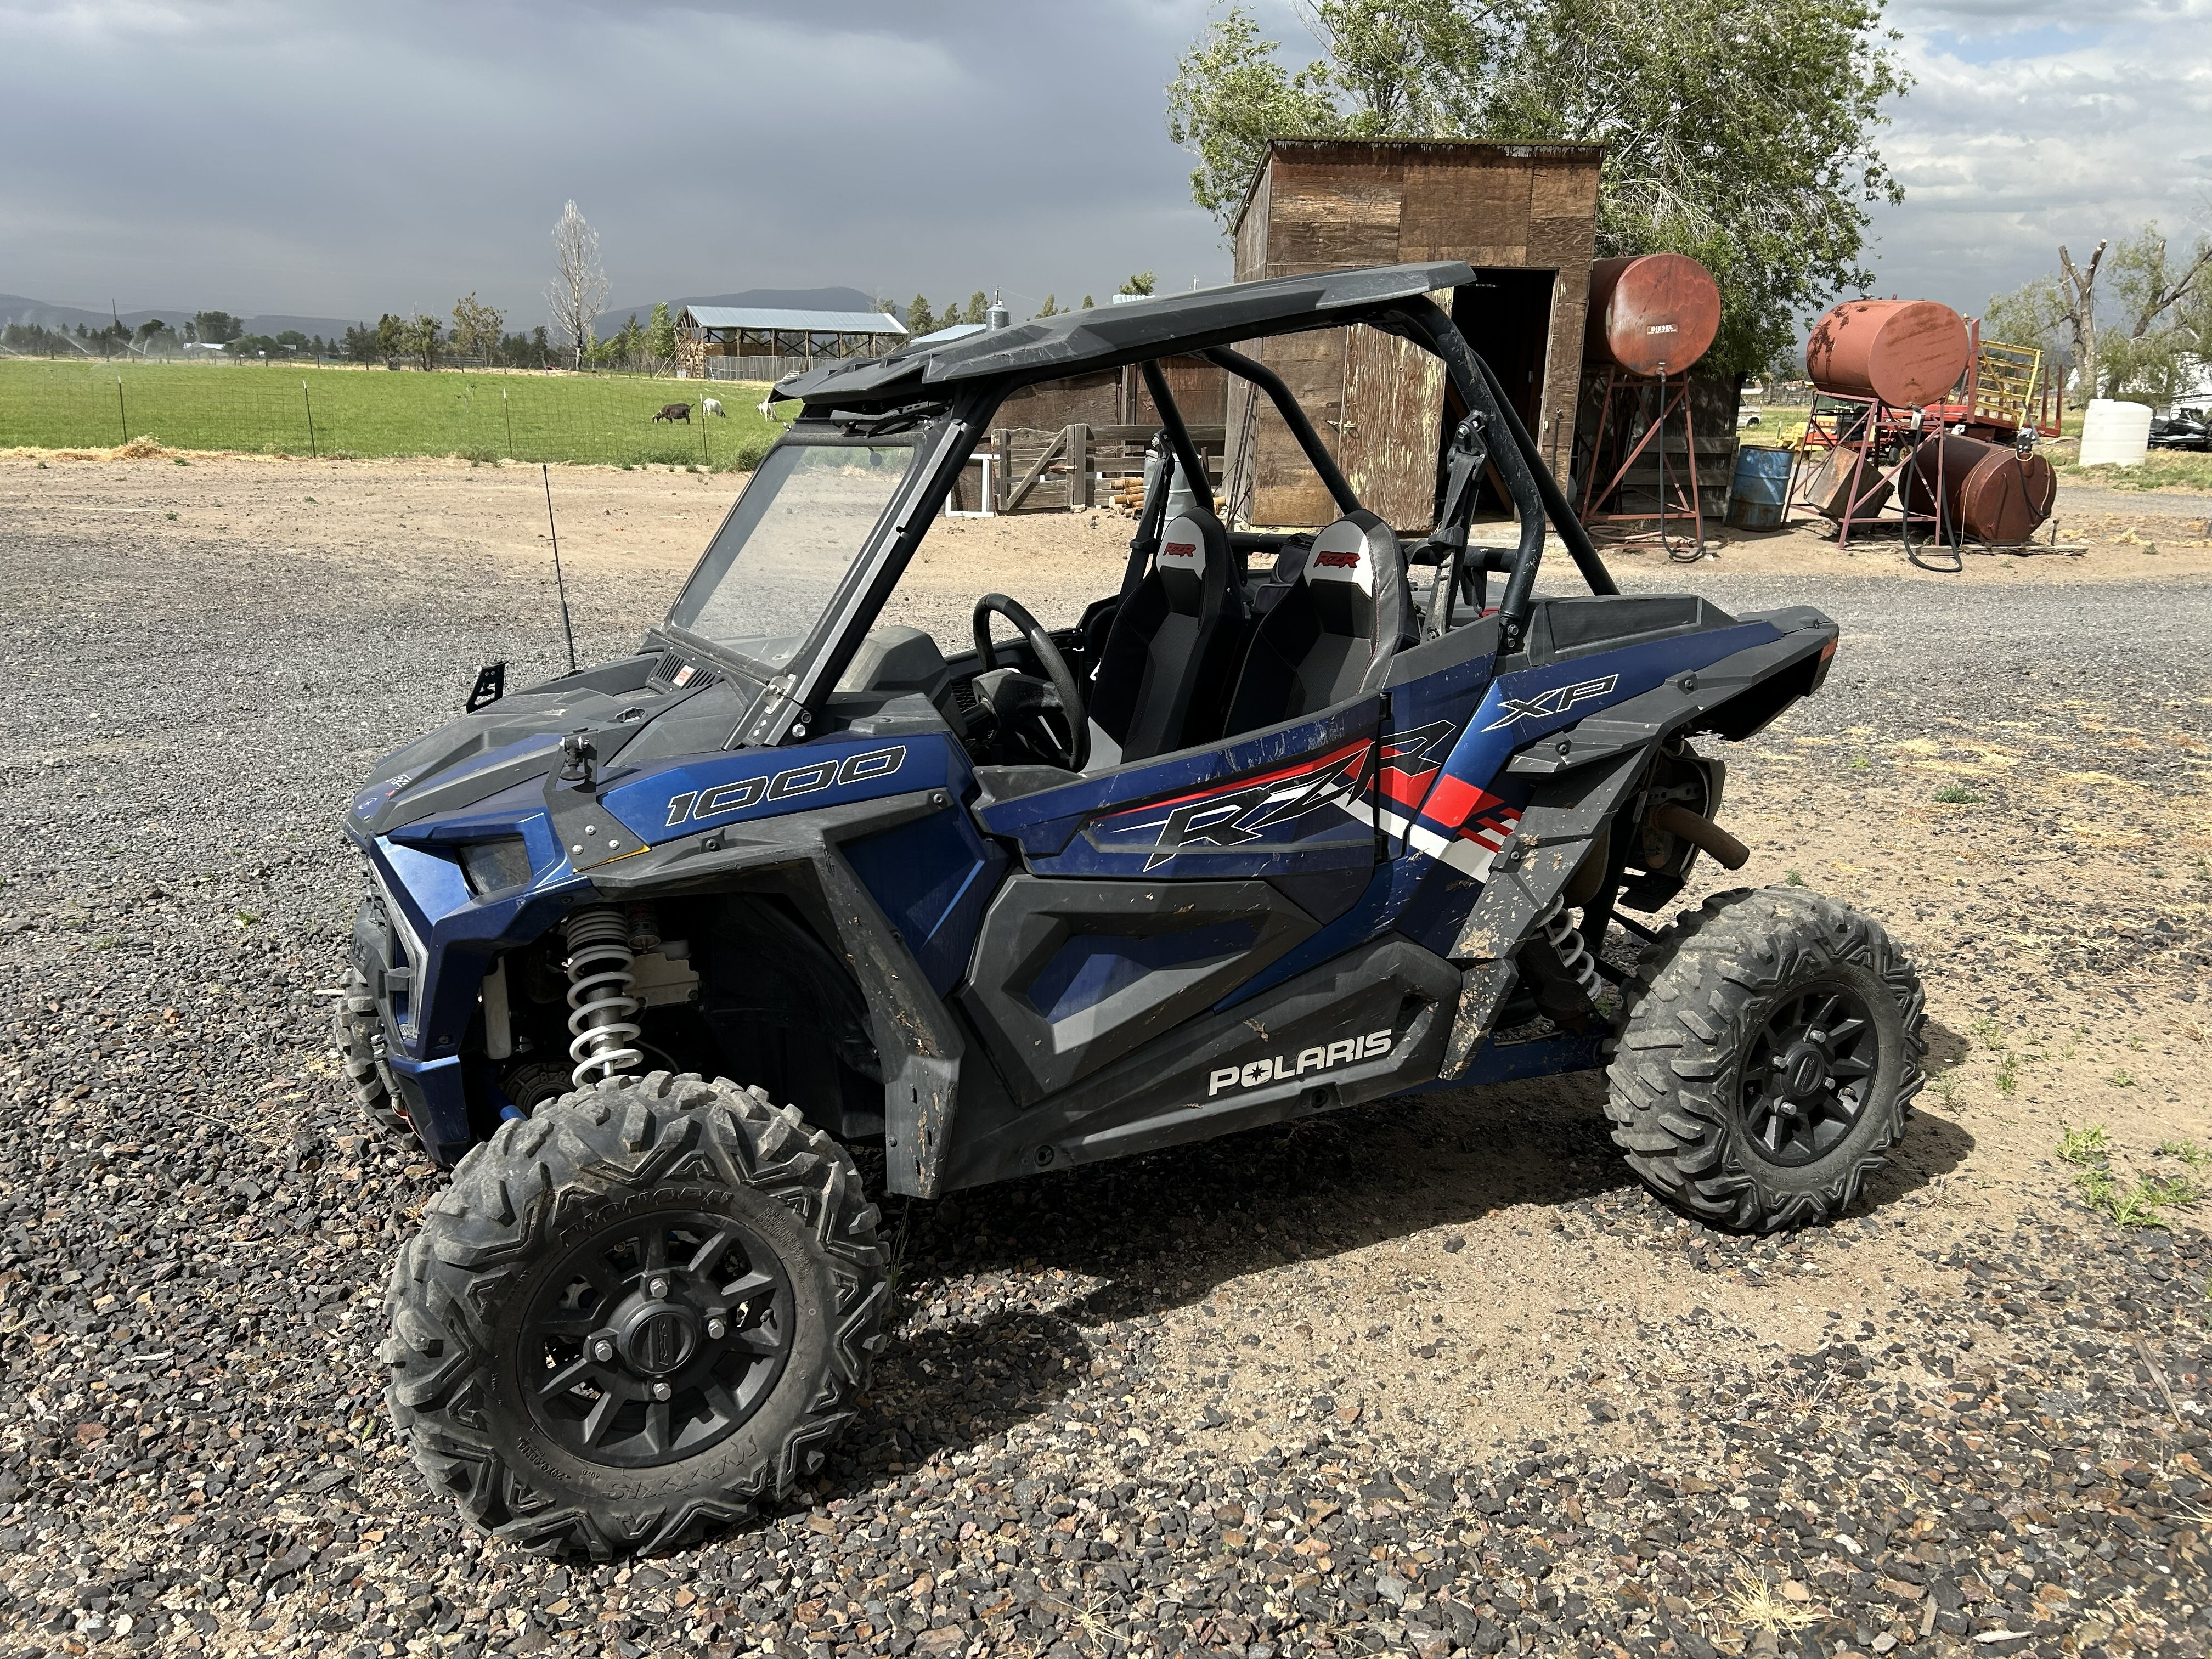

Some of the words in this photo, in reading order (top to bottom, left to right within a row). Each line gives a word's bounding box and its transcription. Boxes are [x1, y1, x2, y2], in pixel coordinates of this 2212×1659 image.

[1163, 542, 1197, 558] RZR
[1313, 551, 1361, 569] RZR
[1480, 674, 1620, 732] XP
[665, 745, 906, 827] 1000
[1143, 719, 1457, 873] RZR
[1208, 1028, 1392, 1096] POLARIS
[601, 1433, 758, 1503] MAXXIS
